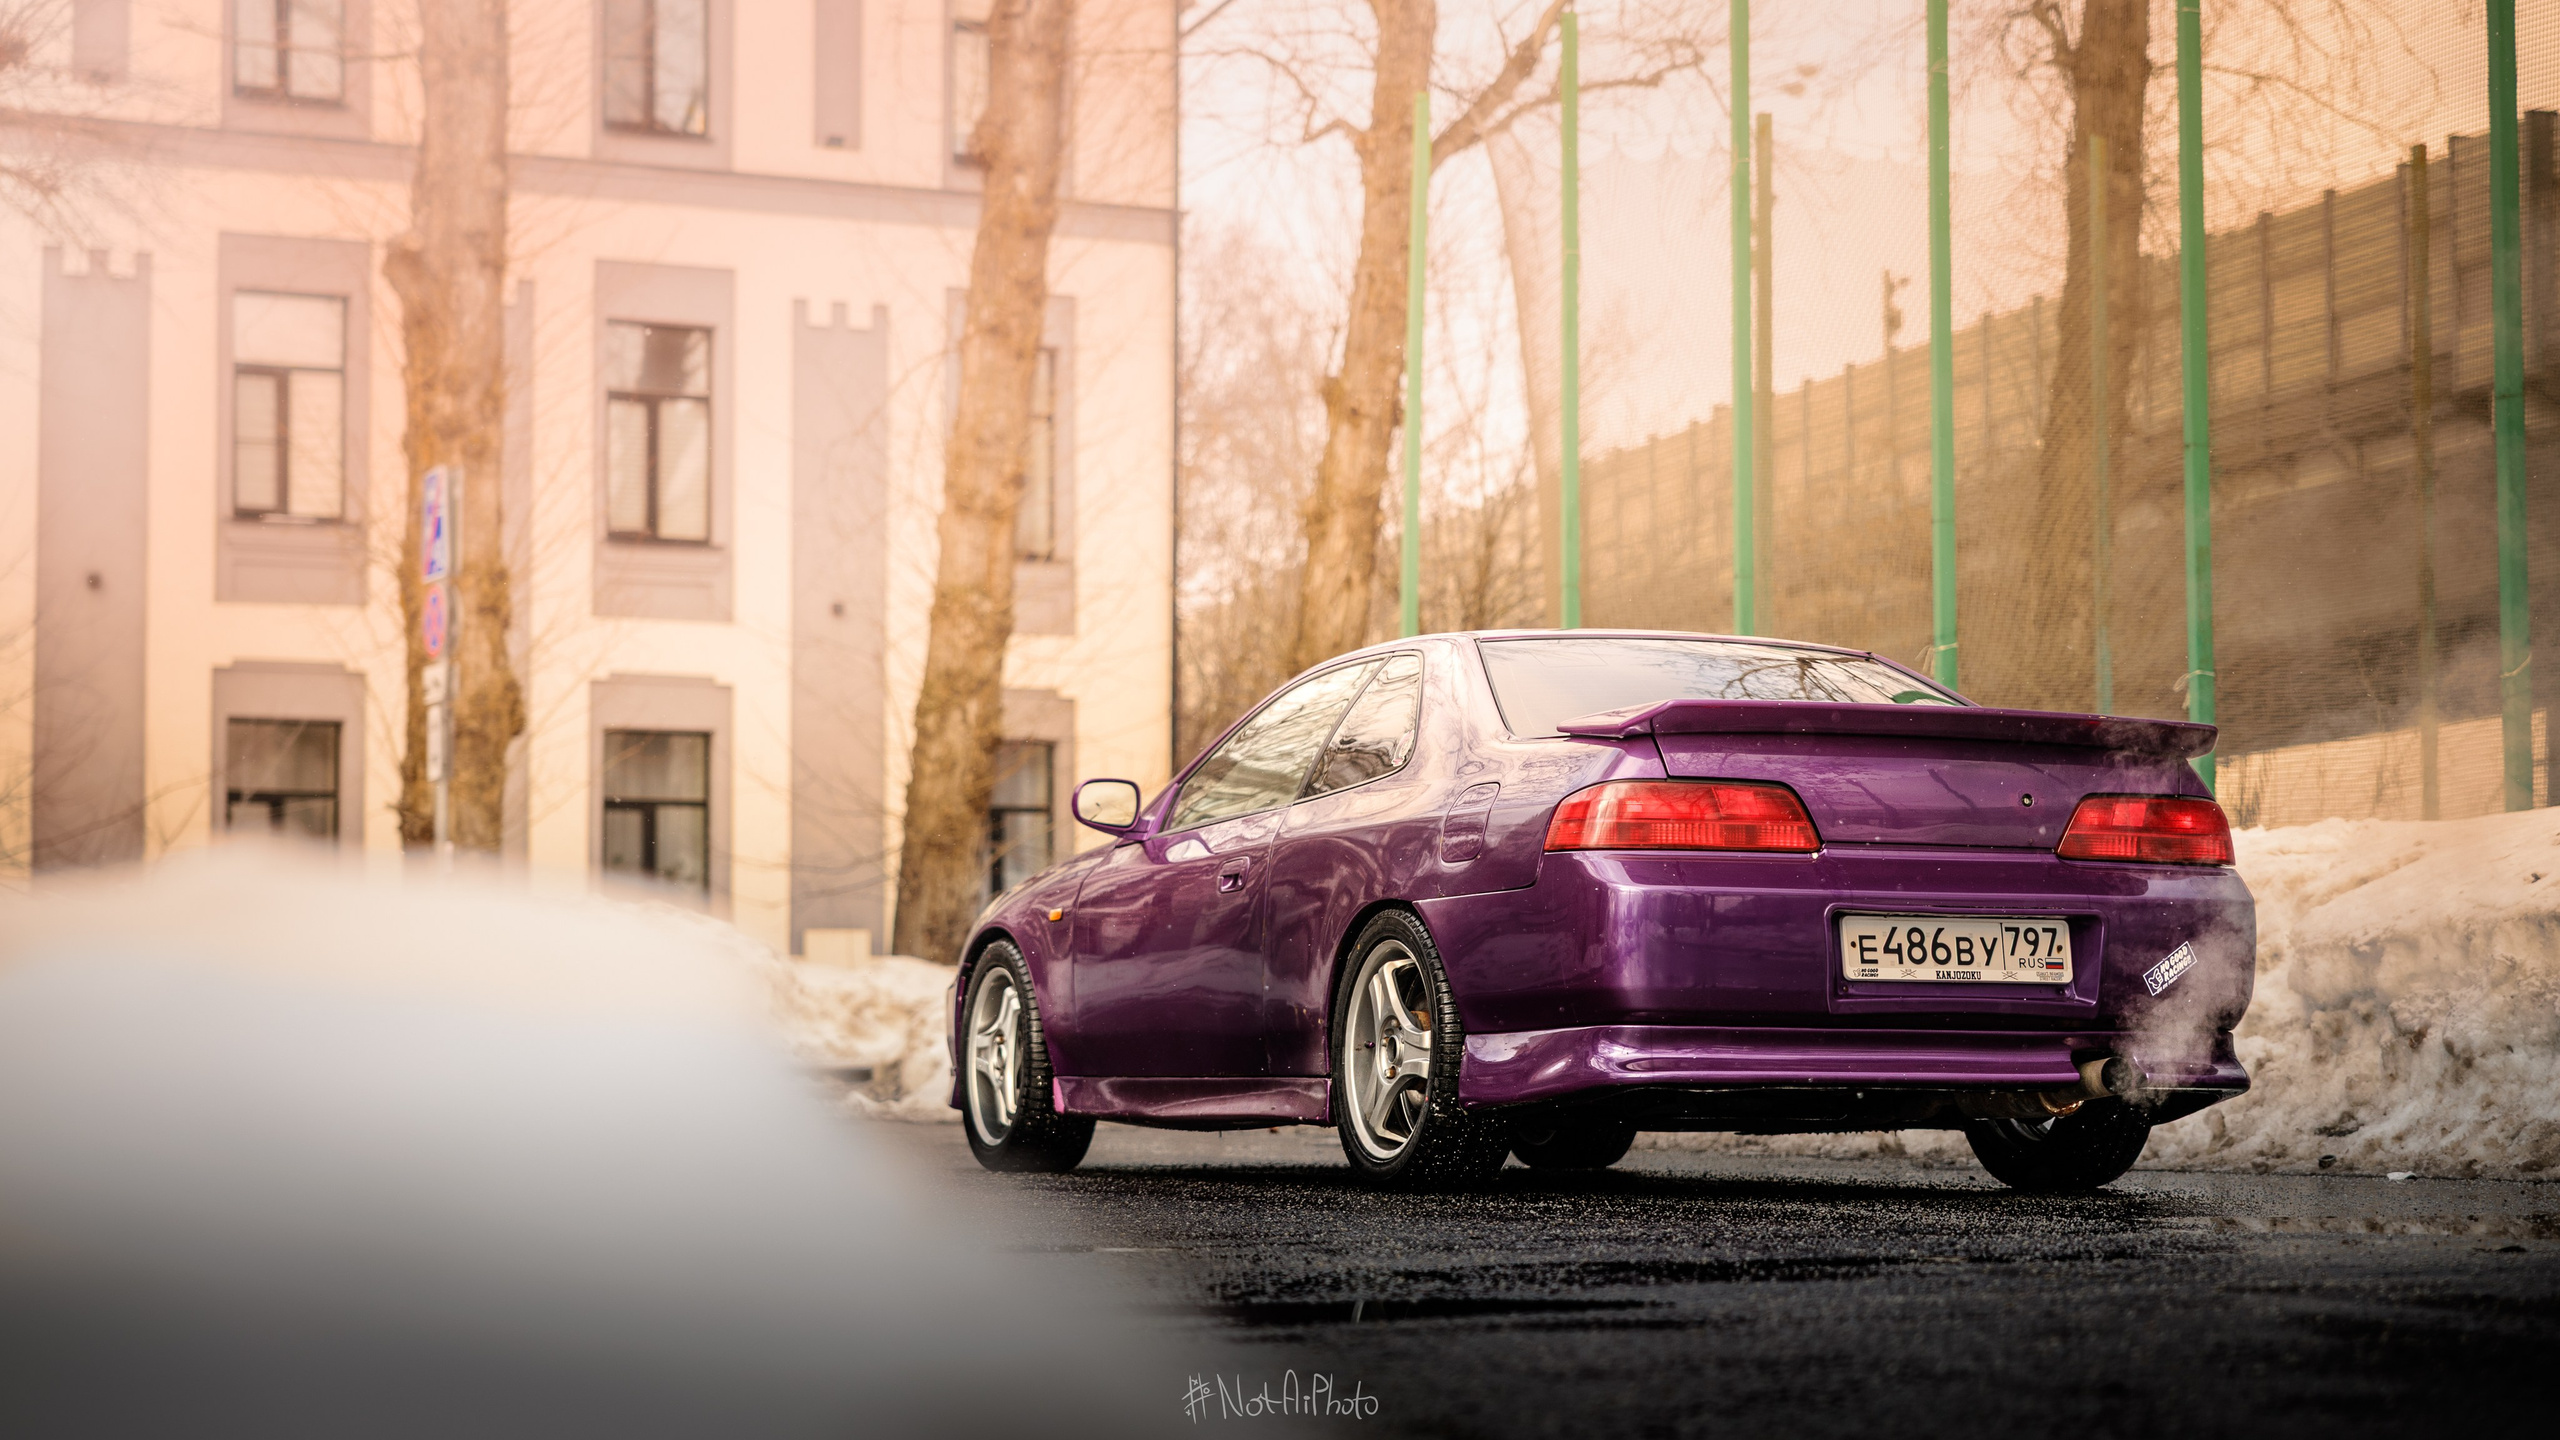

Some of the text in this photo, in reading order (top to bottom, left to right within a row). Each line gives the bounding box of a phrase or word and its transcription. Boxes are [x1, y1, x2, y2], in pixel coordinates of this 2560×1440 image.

[2004, 927, 2057, 957] 797
[2019, 957, 2045, 969] RUS
[2160, 946, 2188, 974] NO GOOD
[1936, 970, 1982, 980] KANJOZOKU
